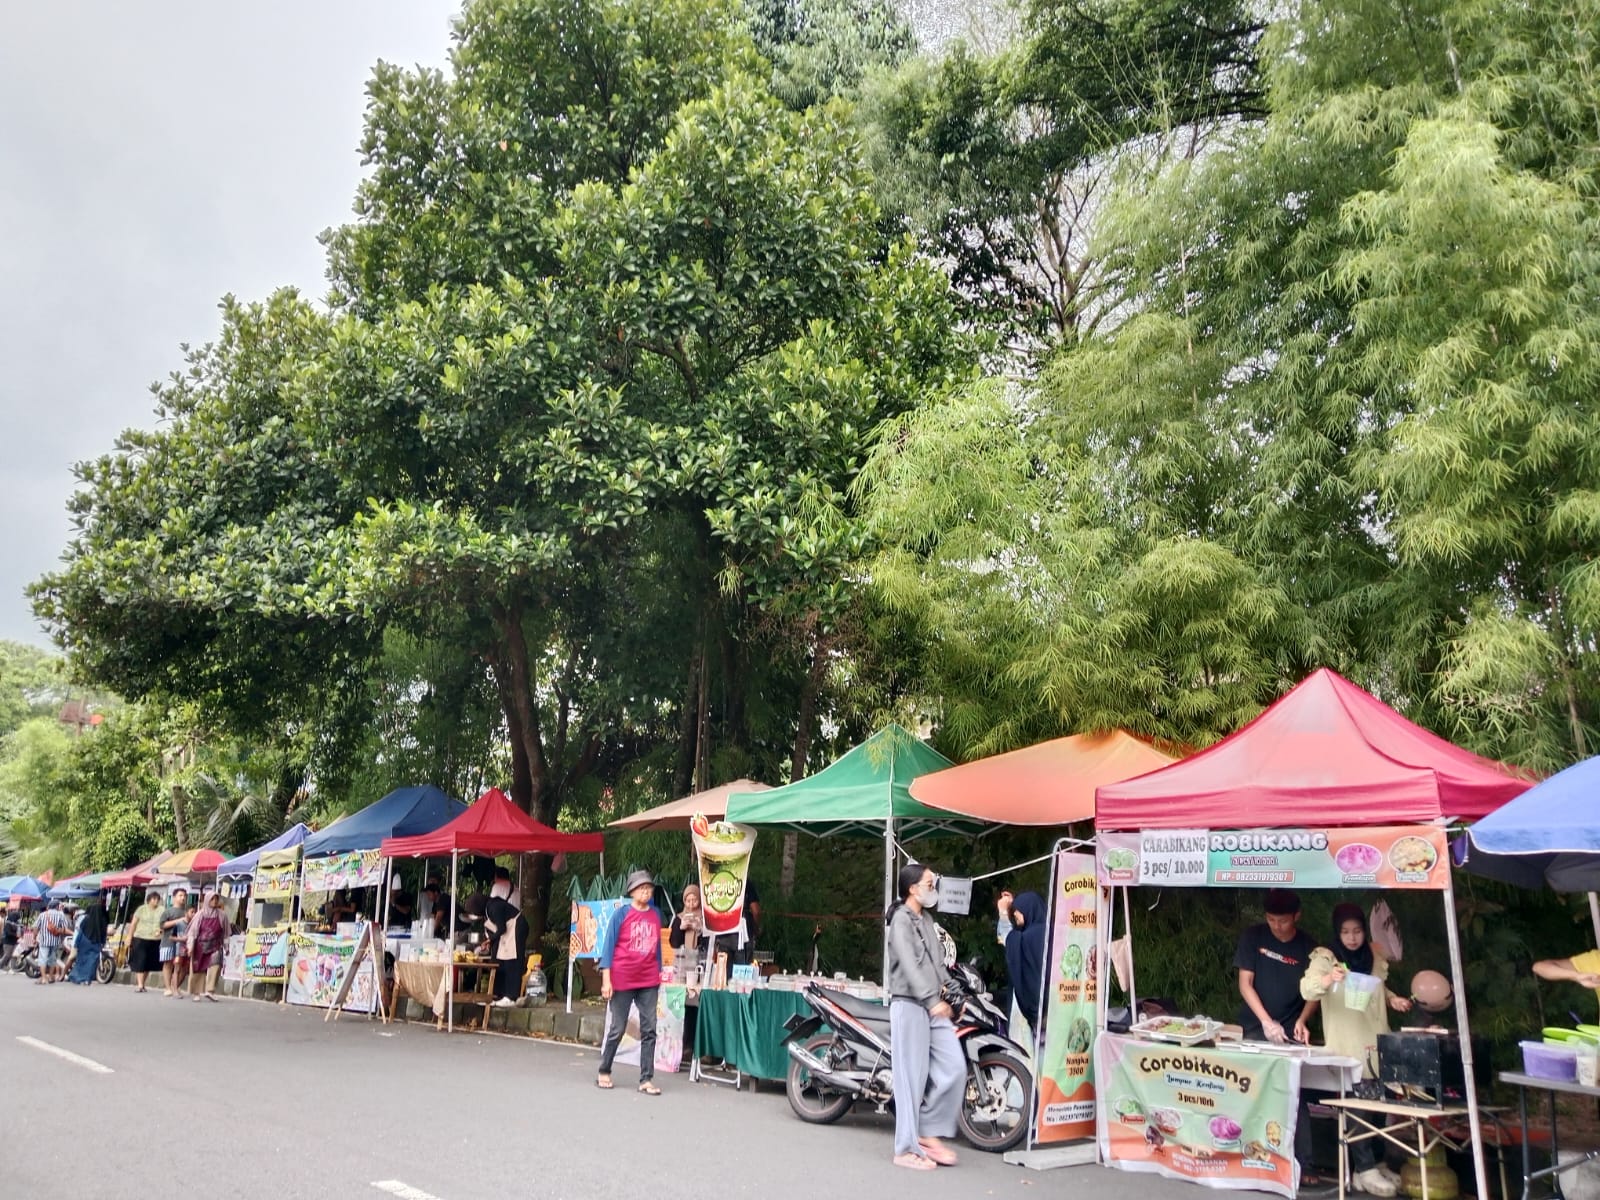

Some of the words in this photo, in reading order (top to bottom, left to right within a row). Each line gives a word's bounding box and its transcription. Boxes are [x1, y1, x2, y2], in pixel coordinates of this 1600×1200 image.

[1209, 832, 1328, 852] ROBIKANG
[1143, 861, 1150, 875] 3
[1174, 861, 1205, 874] 10.000
[1140, 1056, 1251, 1093] Corobikang
